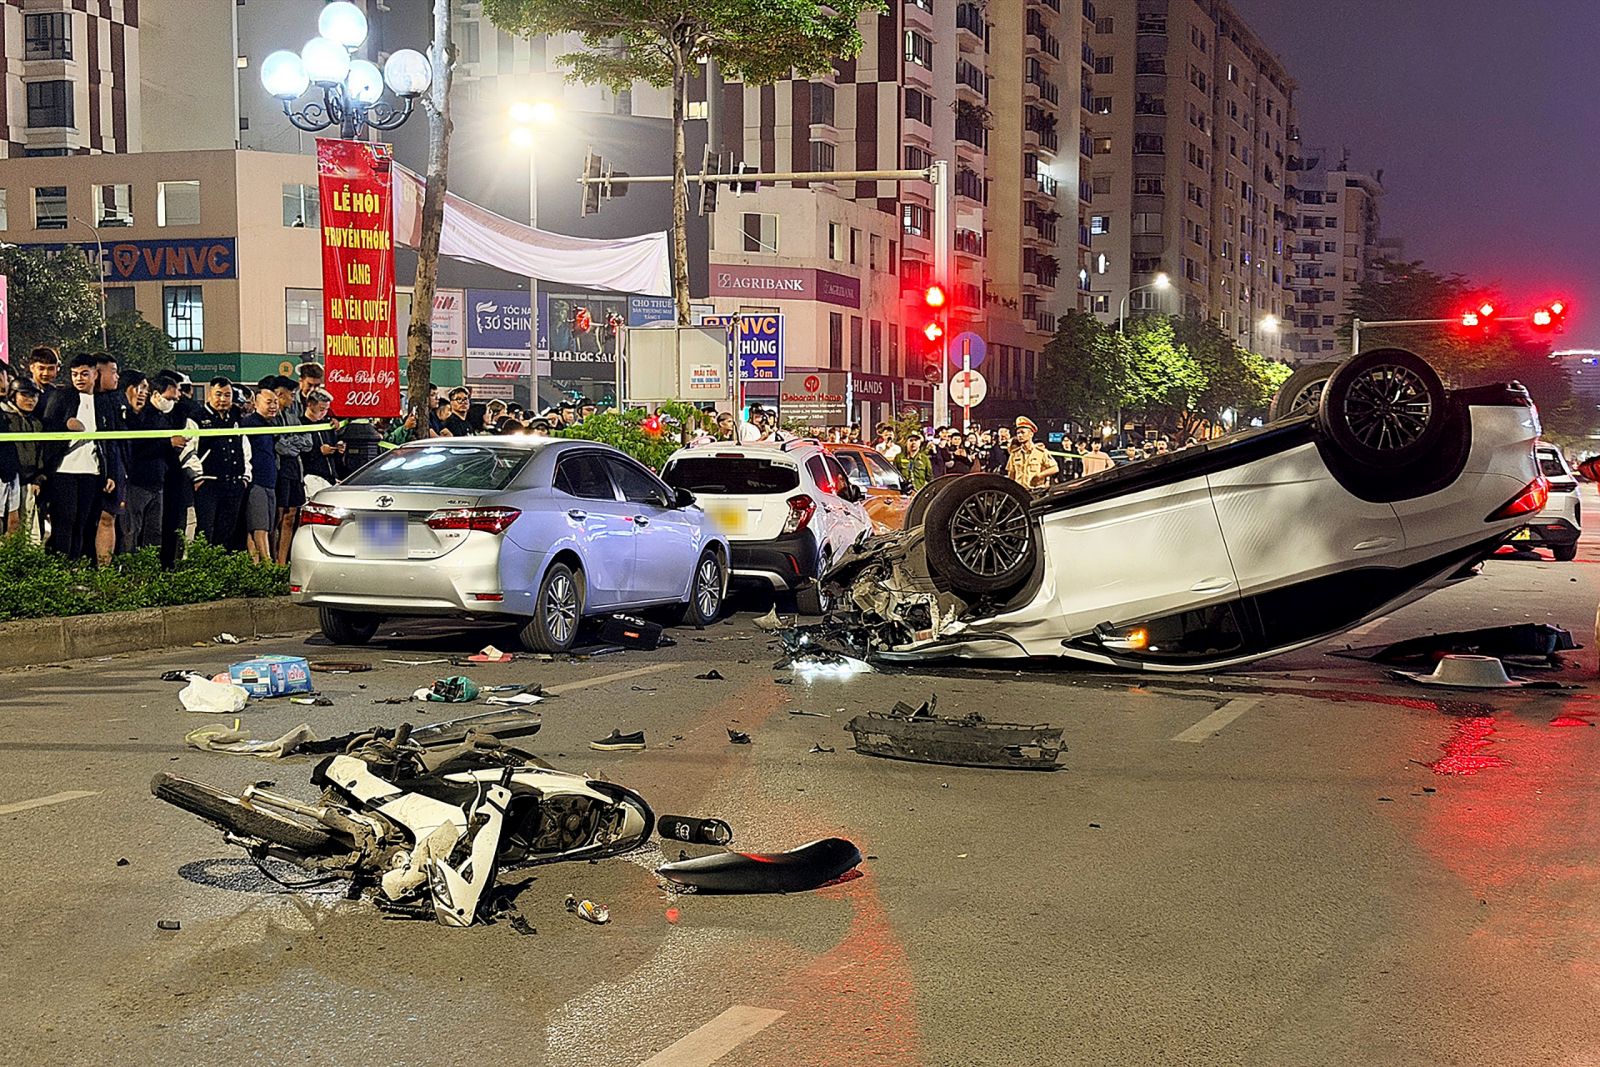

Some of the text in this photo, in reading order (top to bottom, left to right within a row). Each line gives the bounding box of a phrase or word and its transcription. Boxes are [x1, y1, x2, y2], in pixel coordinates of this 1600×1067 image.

[333, 184, 380, 217] LỄ HỘI
[361, 223, 390, 251] THỐNG
[142, 244, 230, 276] VNVC
[347, 259, 371, 285] LÀNG
[732, 277, 805, 291] AGRIBANK
[331, 292, 389, 324] HẠ YÊN QUYẾT
[503, 304, 539, 316] TÓC NA
[326, 330, 395, 358] PHƯỜNG YÊN HÒA
[345, 389, 381, 406] 2026
[781, 393, 817, 402] Deborah
